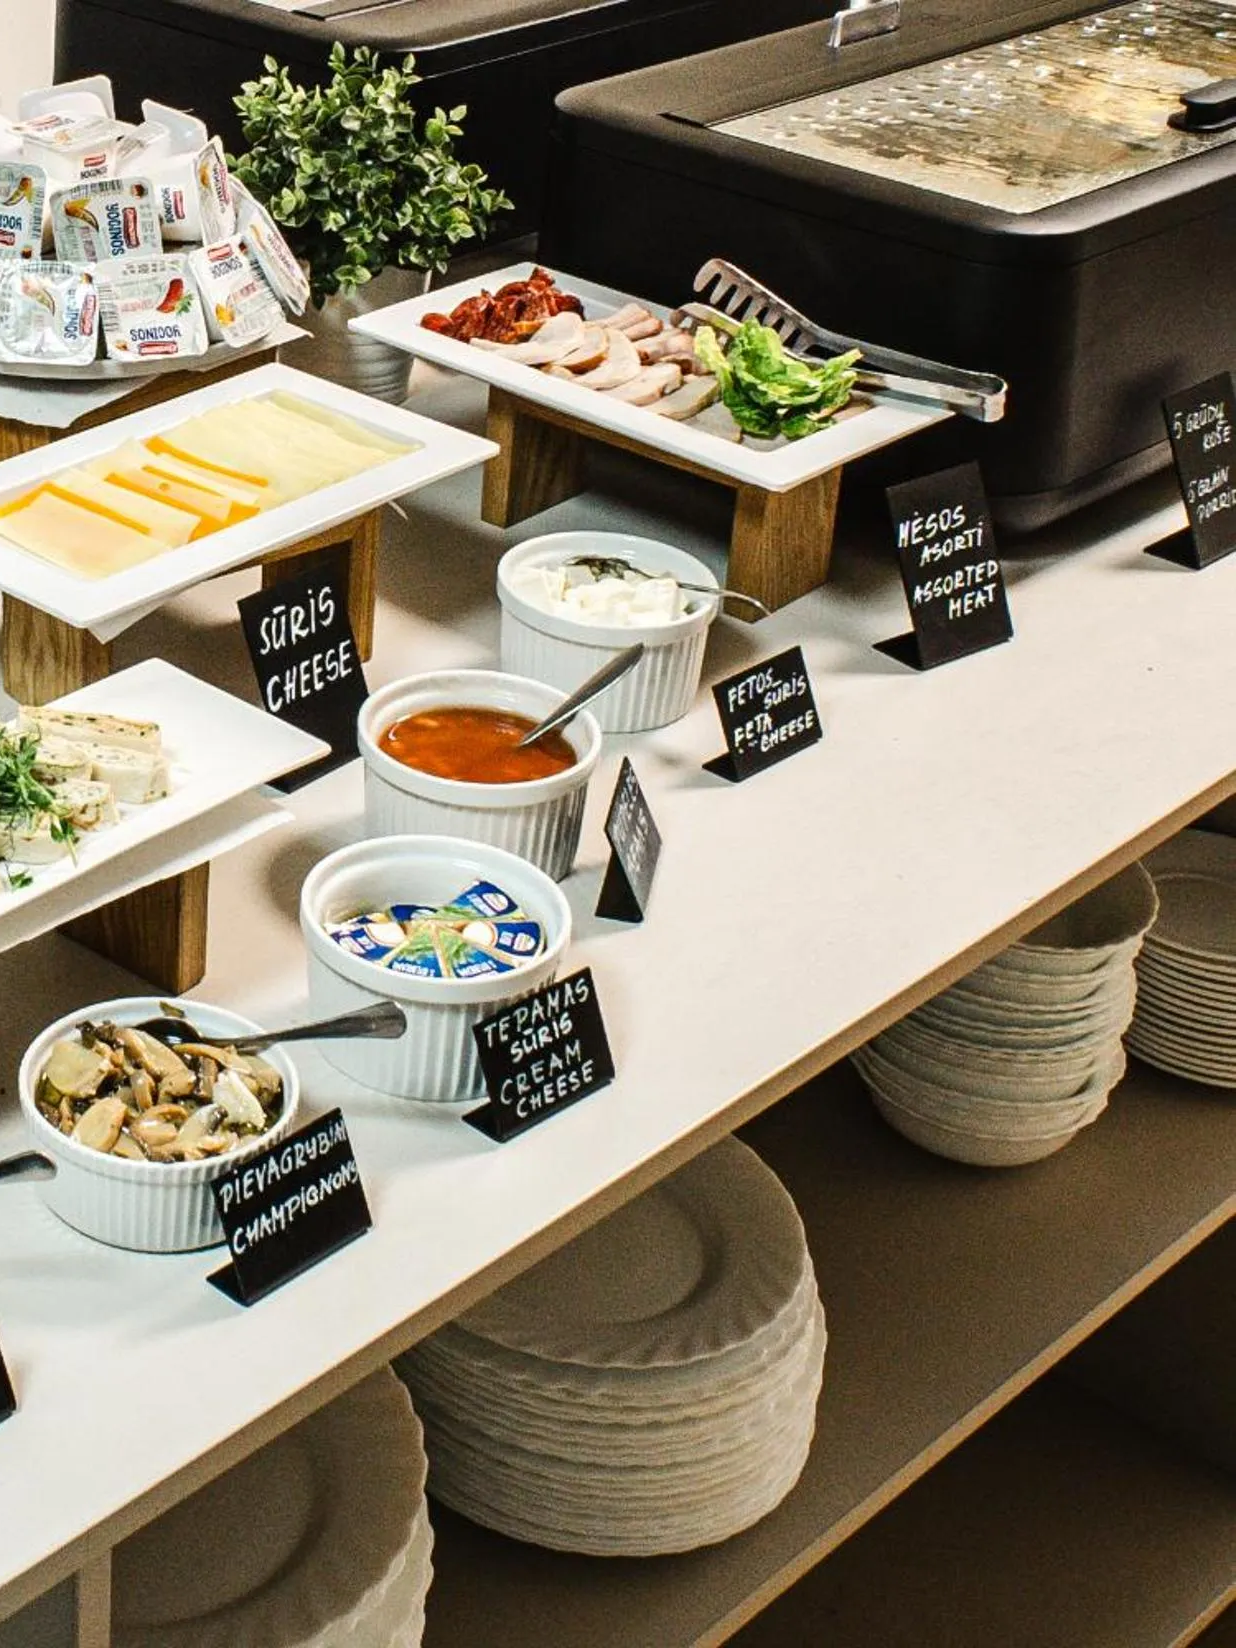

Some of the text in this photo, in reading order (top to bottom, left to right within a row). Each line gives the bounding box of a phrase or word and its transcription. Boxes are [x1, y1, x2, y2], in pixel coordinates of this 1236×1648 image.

[919, 521, 983, 567] ASORTI
[913, 560, 999, 608] ASSORTED
[948, 583, 997, 620] MEAT
[260, 586, 335, 655] SŪRIS
[266, 639, 353, 713] CHEESE
[727, 667, 773, 713] FETOS
[734, 712, 773, 748] FETA
[760, 709, 814, 752] CHEESE
[484, 977, 589, 1048] TEPAMAS
[510, 1011, 572, 1063] SŪRIS
[500, 1039, 582, 1105] CREAM
[516, 1059, 594, 1118] CHEESE
[233, 1159, 359, 1255] CHAMPIGNONS
